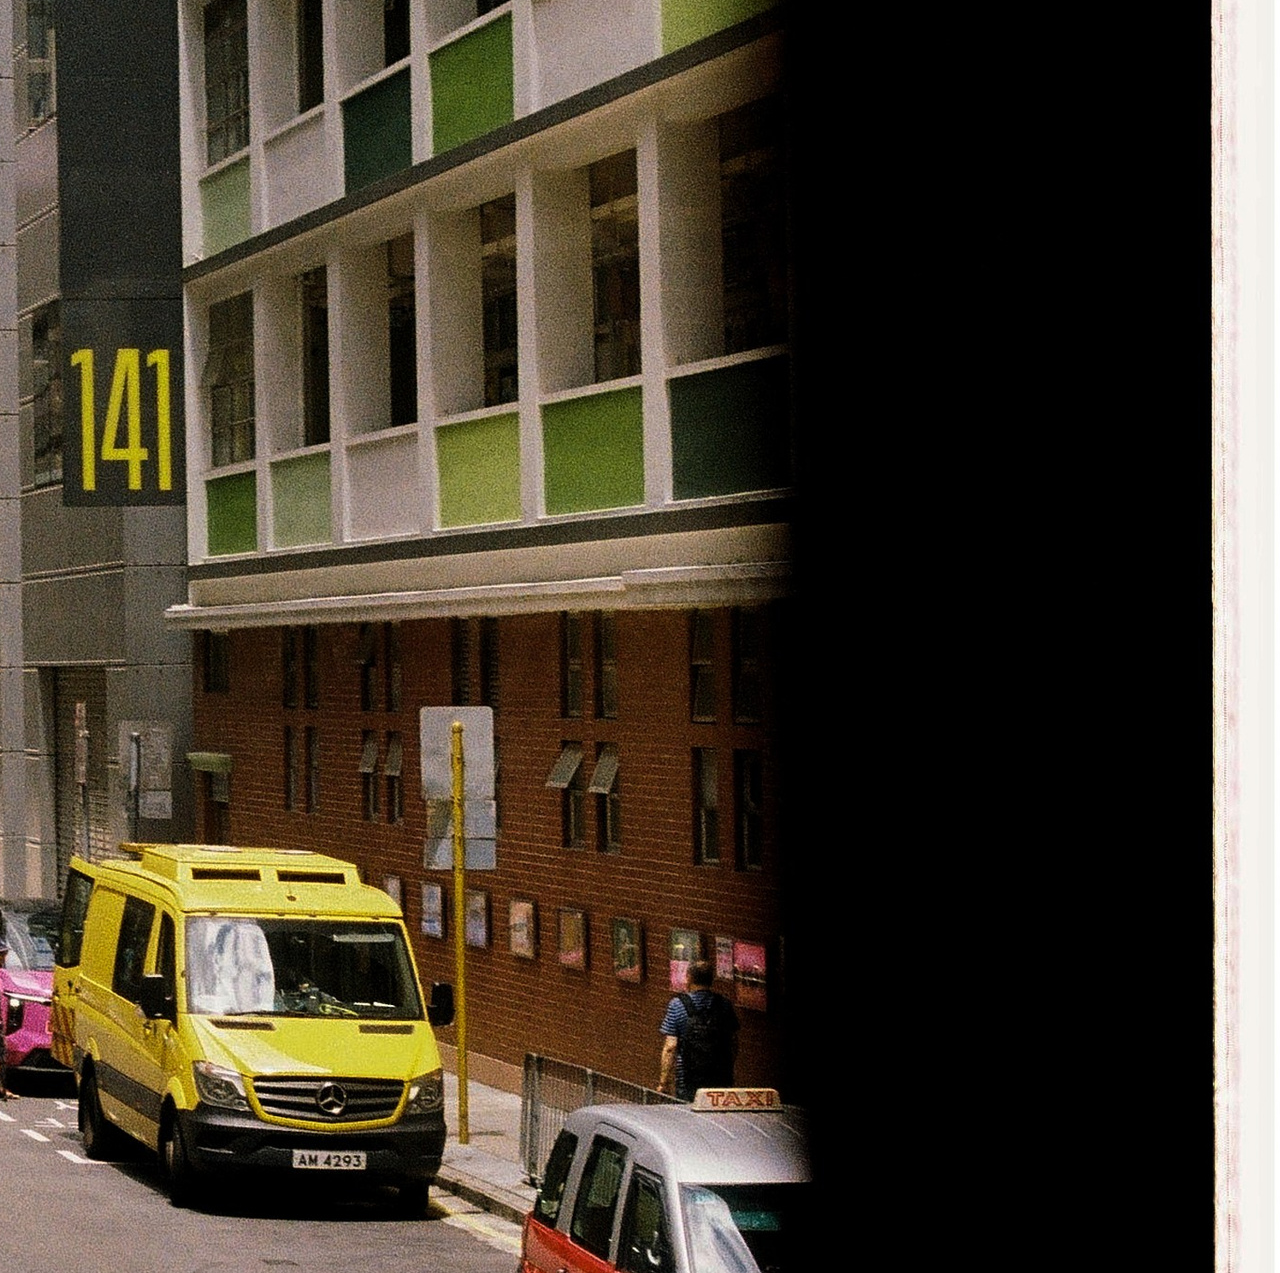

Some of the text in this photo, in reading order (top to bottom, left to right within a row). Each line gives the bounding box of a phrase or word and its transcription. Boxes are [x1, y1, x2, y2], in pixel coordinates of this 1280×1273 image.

[71, 348, 172, 491] 141
[706, 1091, 775, 1106] TAXI
[299, 1154, 362, 1167] AM 4293
